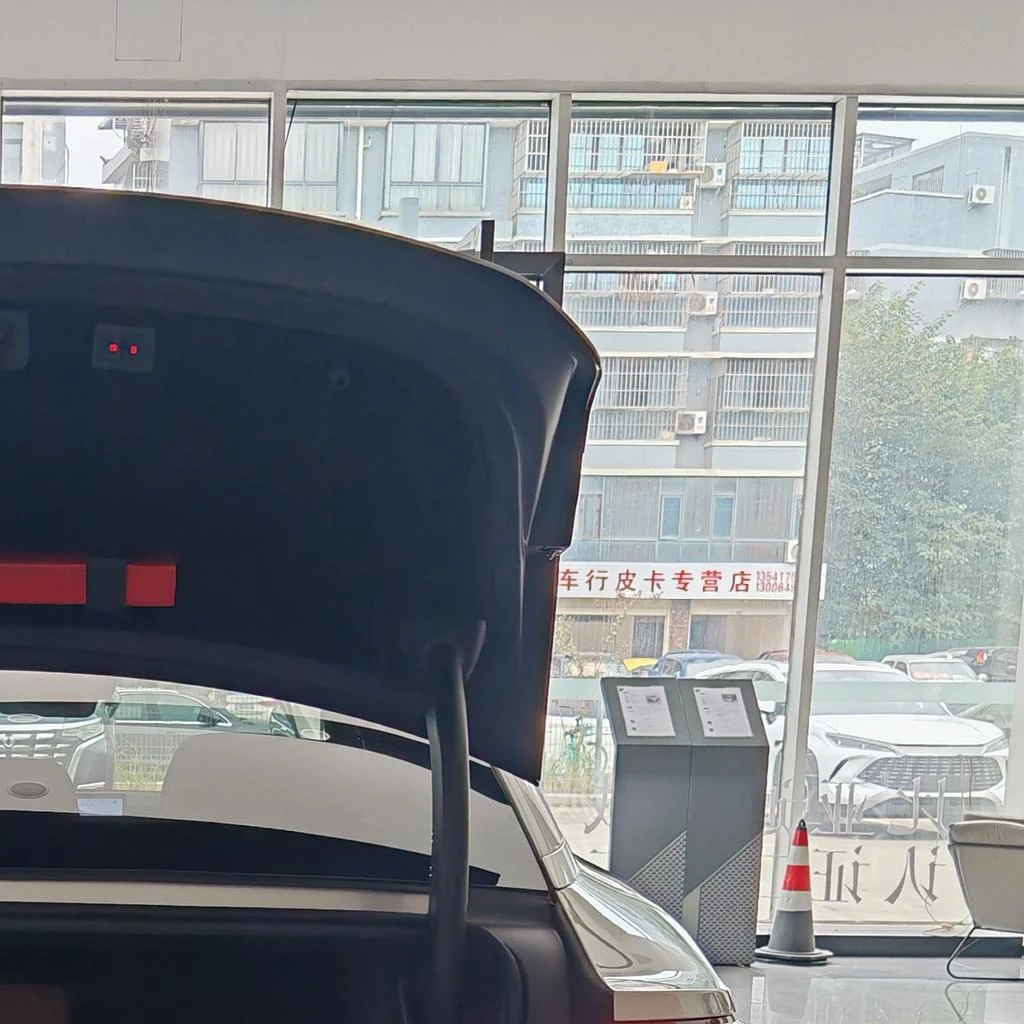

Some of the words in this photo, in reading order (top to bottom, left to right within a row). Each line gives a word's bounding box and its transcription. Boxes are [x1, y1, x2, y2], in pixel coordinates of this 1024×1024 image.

[560, 569, 751, 593] 车行皮卡专营店
